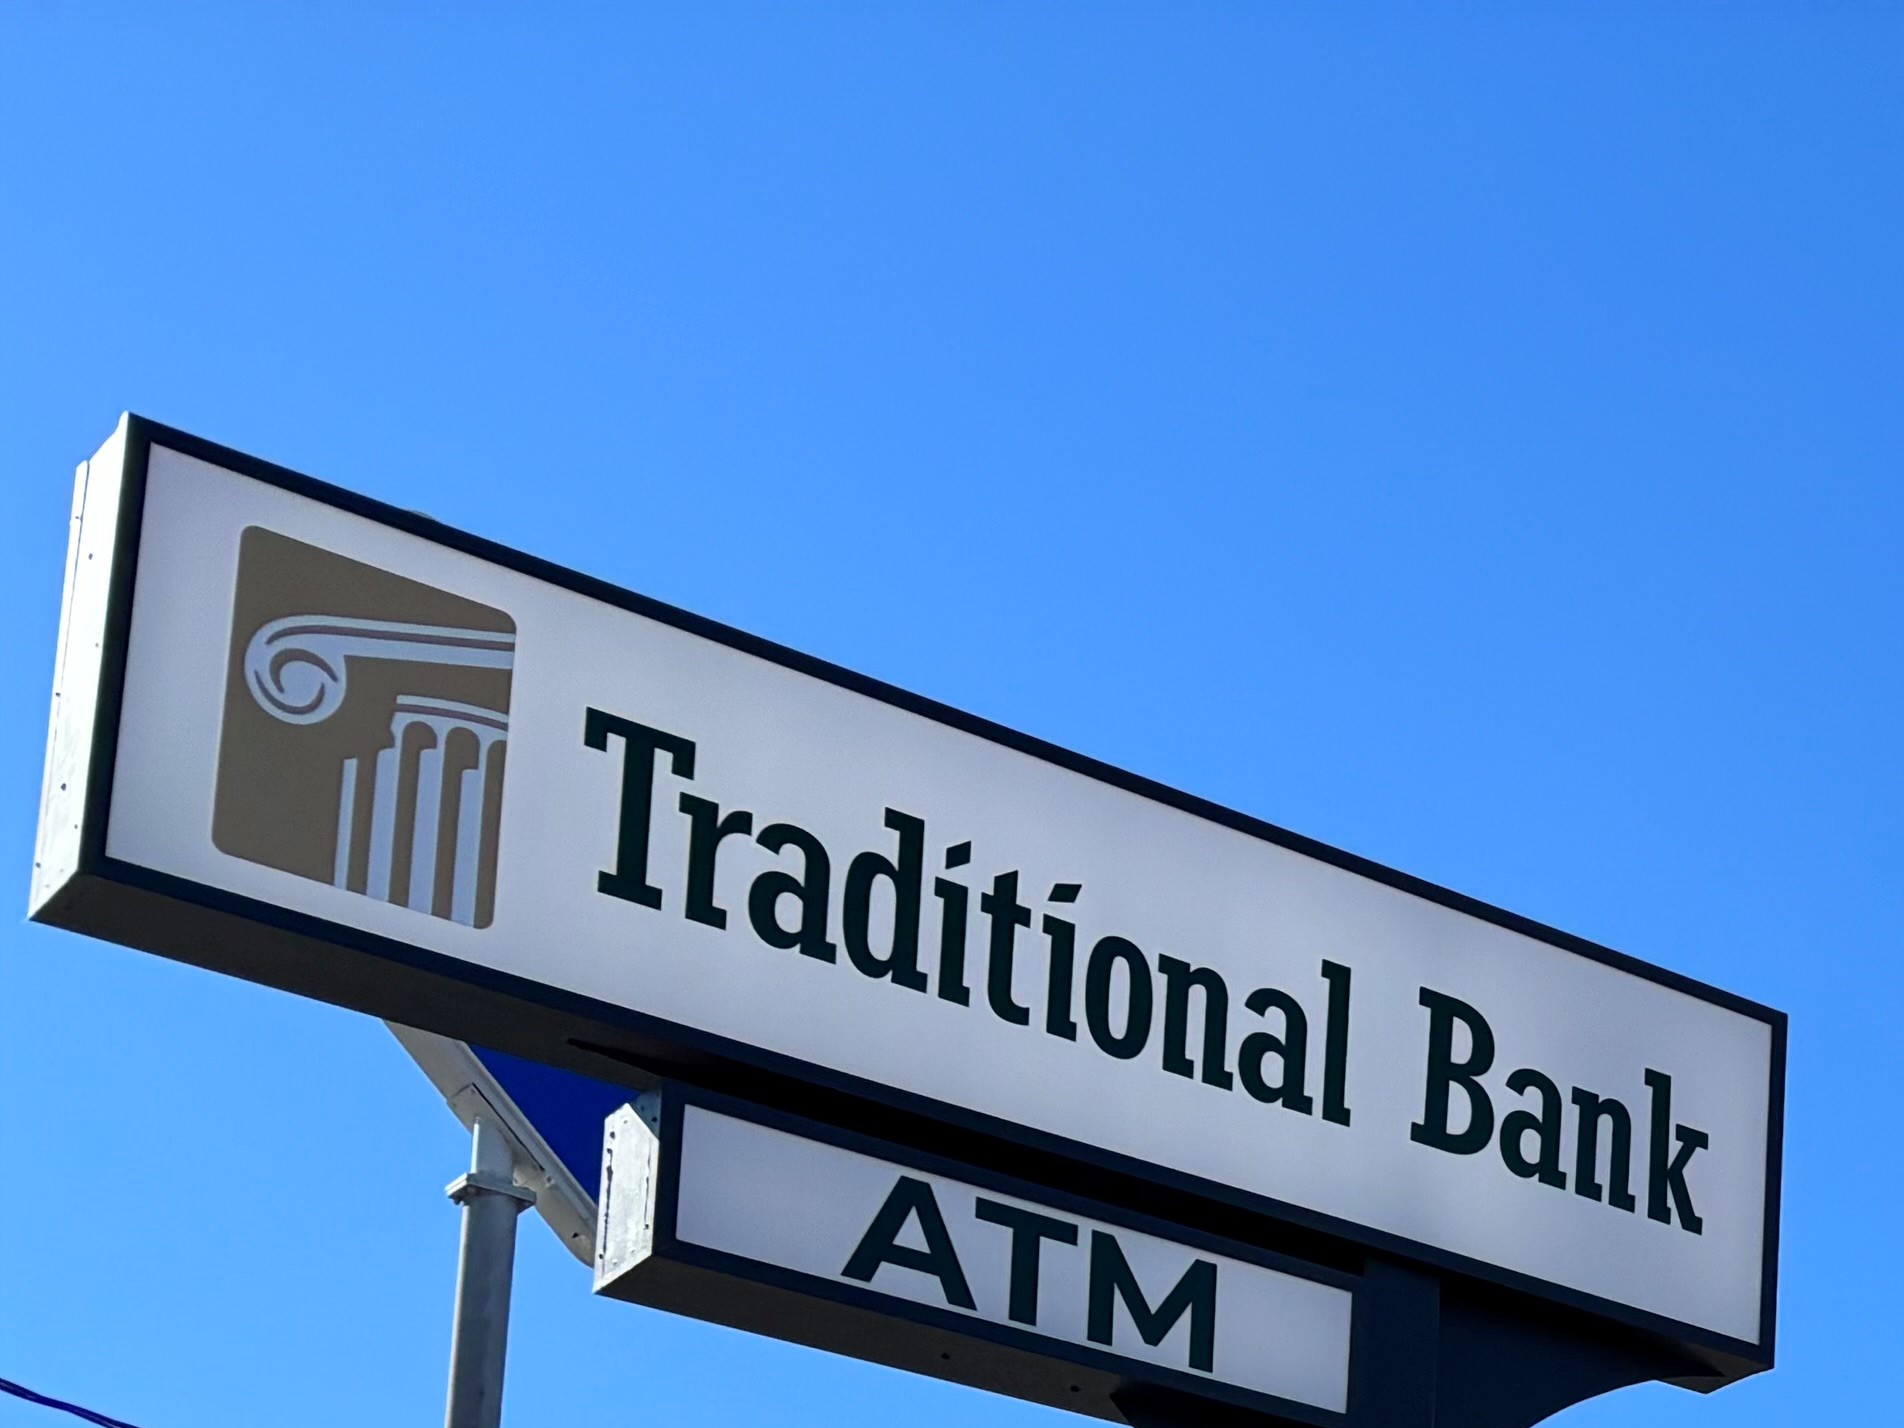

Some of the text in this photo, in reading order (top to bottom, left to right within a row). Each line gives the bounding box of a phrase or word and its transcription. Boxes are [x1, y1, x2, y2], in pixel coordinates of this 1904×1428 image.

[584, 707, 1709, 1235] Traditional Bank
[841, 1174, 1219, 1373] ATM
